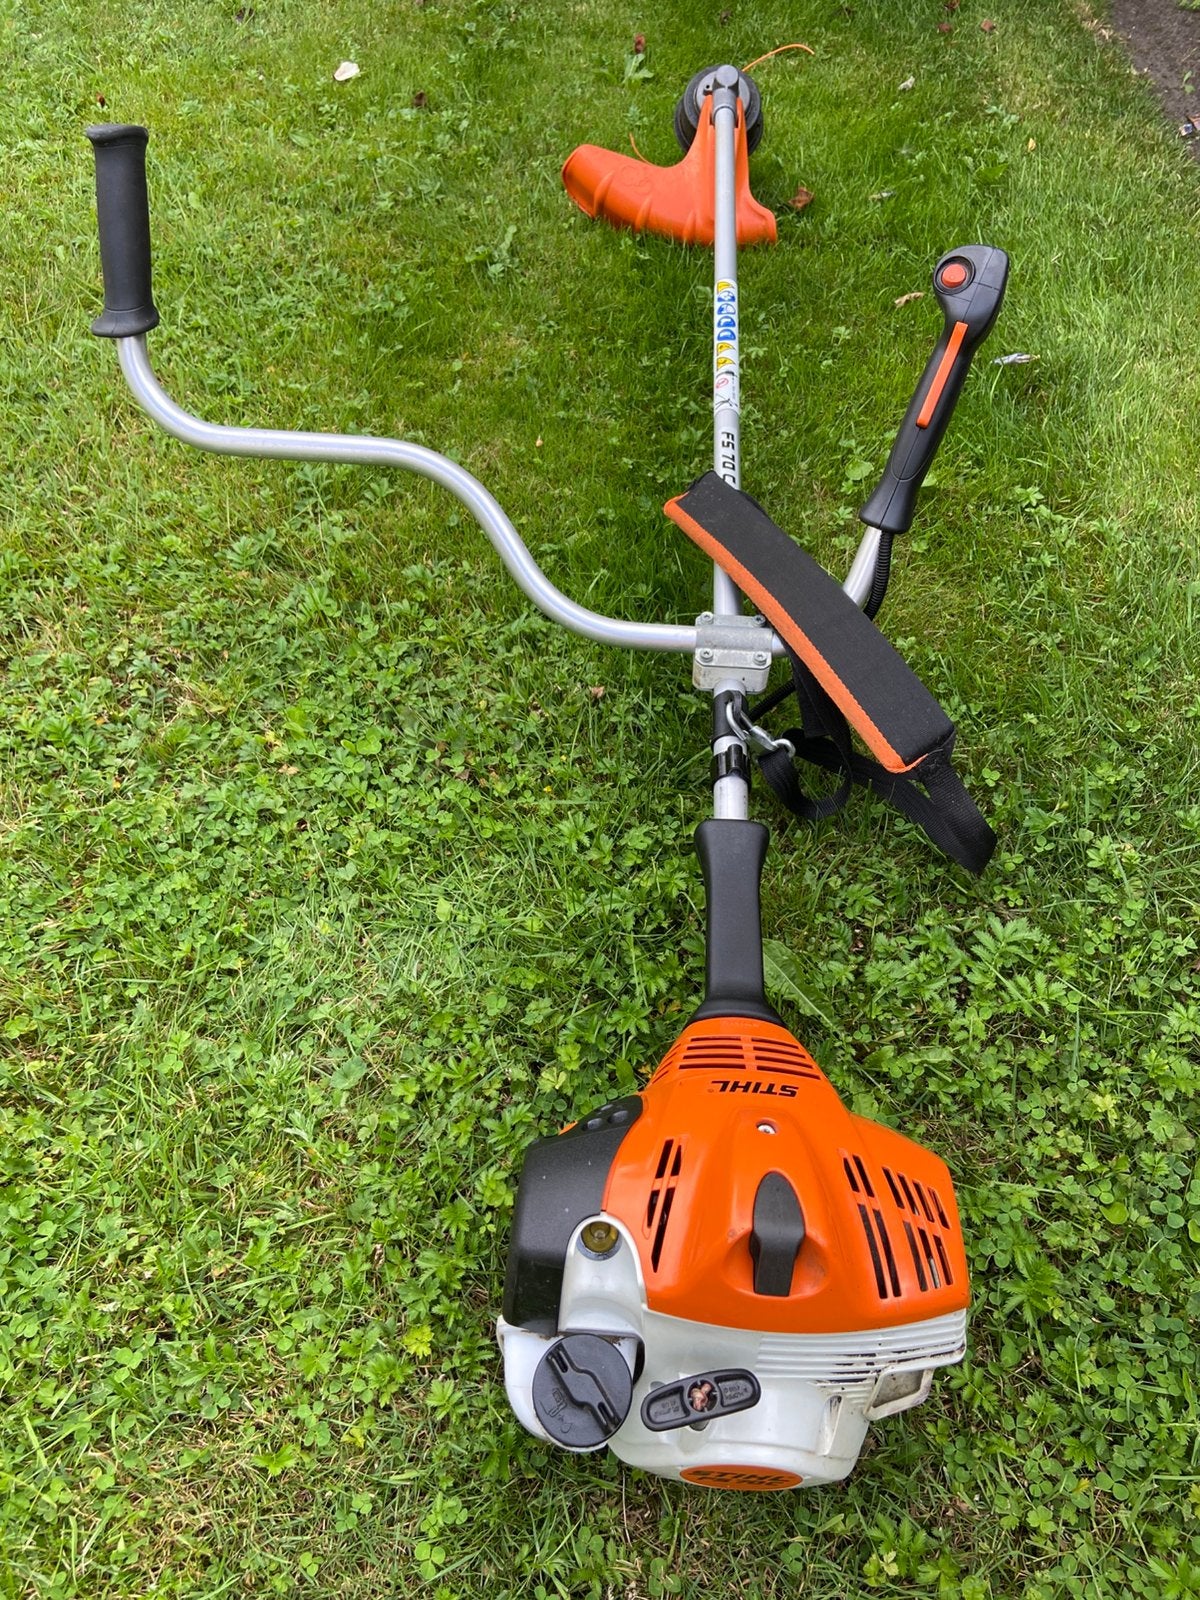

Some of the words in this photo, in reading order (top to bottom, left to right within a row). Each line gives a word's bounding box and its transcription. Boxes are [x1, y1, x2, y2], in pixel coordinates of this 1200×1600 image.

[721, 431, 735, 451] FS
[721, 454, 736, 472] 70
[711, 1080, 799, 1098] STIHL
